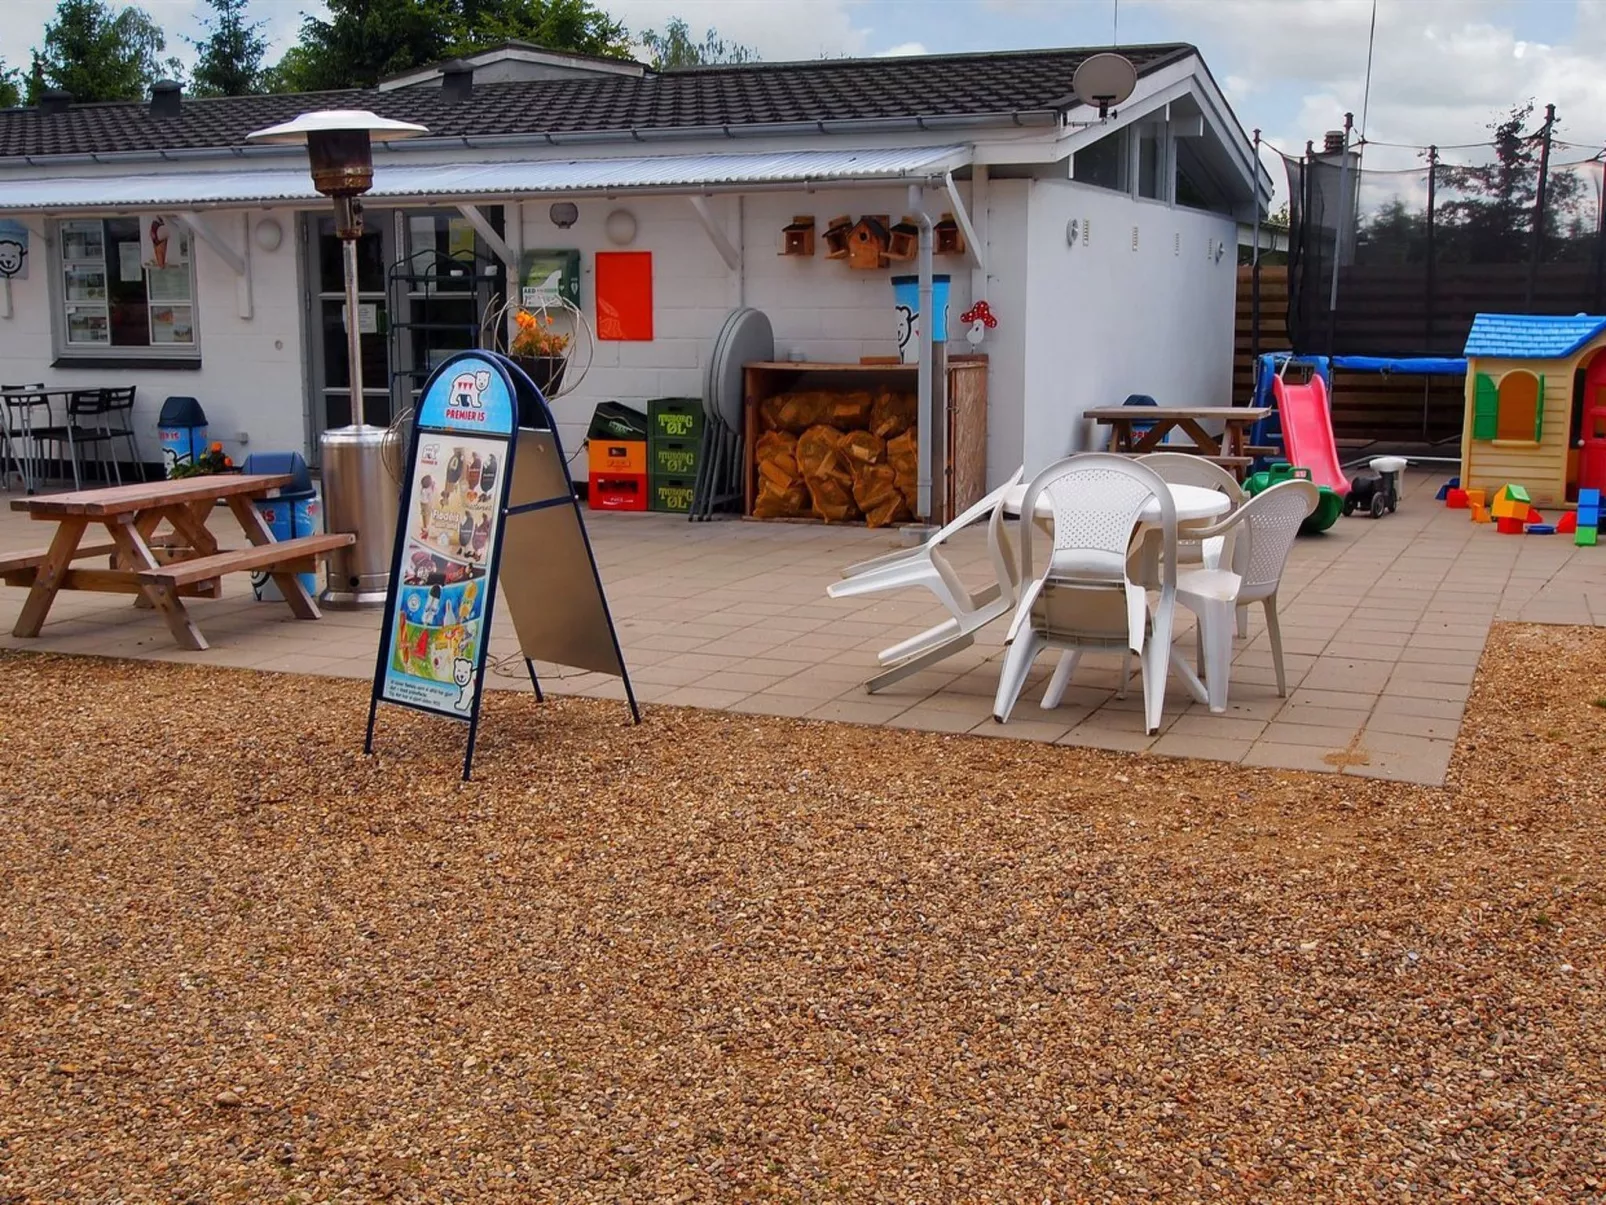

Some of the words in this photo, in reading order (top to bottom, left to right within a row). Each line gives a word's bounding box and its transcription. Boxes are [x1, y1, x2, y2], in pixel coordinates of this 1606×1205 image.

[446, 409, 477, 421] PREMIER
[477, 411, 485, 421] IS
[658, 414, 693, 428] TUBORG
[667, 421, 687, 435] ØL
[658, 451, 694, 465] TUBORG
[667, 459, 687, 472] ØL
[658, 488, 694, 502] TUBORG
[667, 496, 687, 509] ØL
